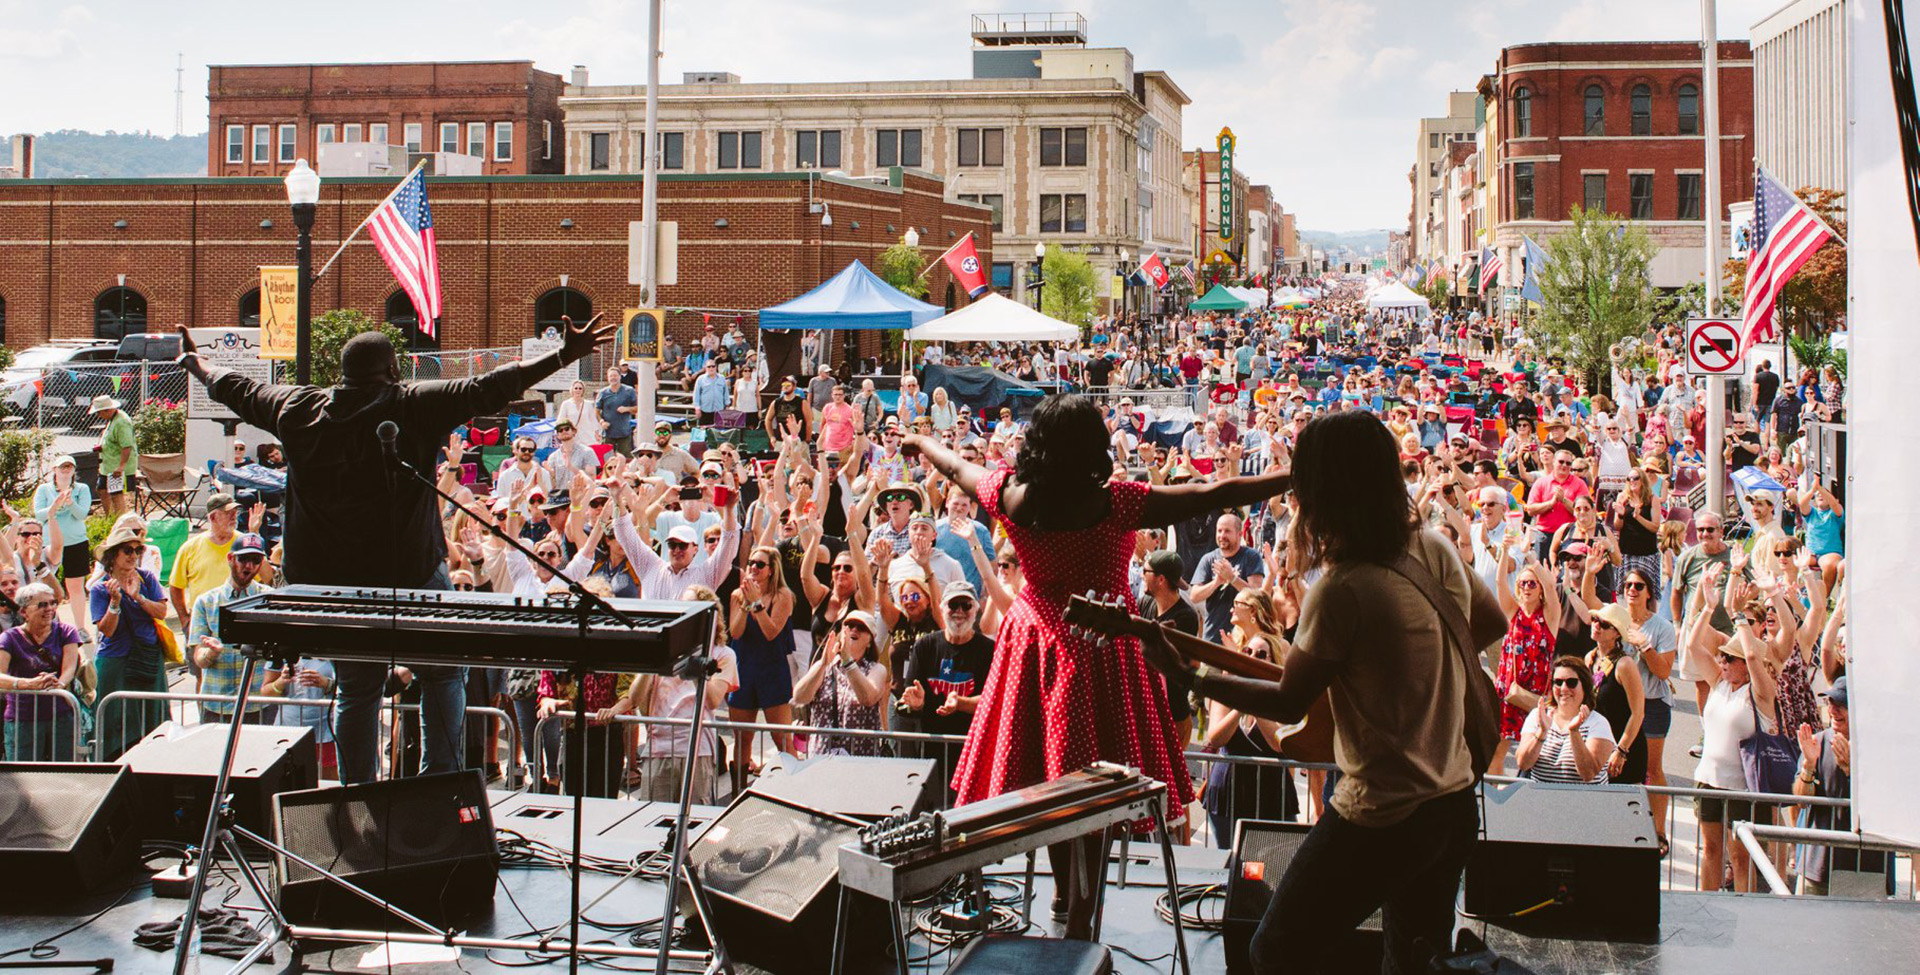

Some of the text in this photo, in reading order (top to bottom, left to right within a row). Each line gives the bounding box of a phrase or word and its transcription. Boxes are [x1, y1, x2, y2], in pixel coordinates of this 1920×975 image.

[1221, 137, 1230, 237] PARAMOUNT
[1081, 246, 1100, 254] Lynch
[270, 281, 295, 294] Rhythm
